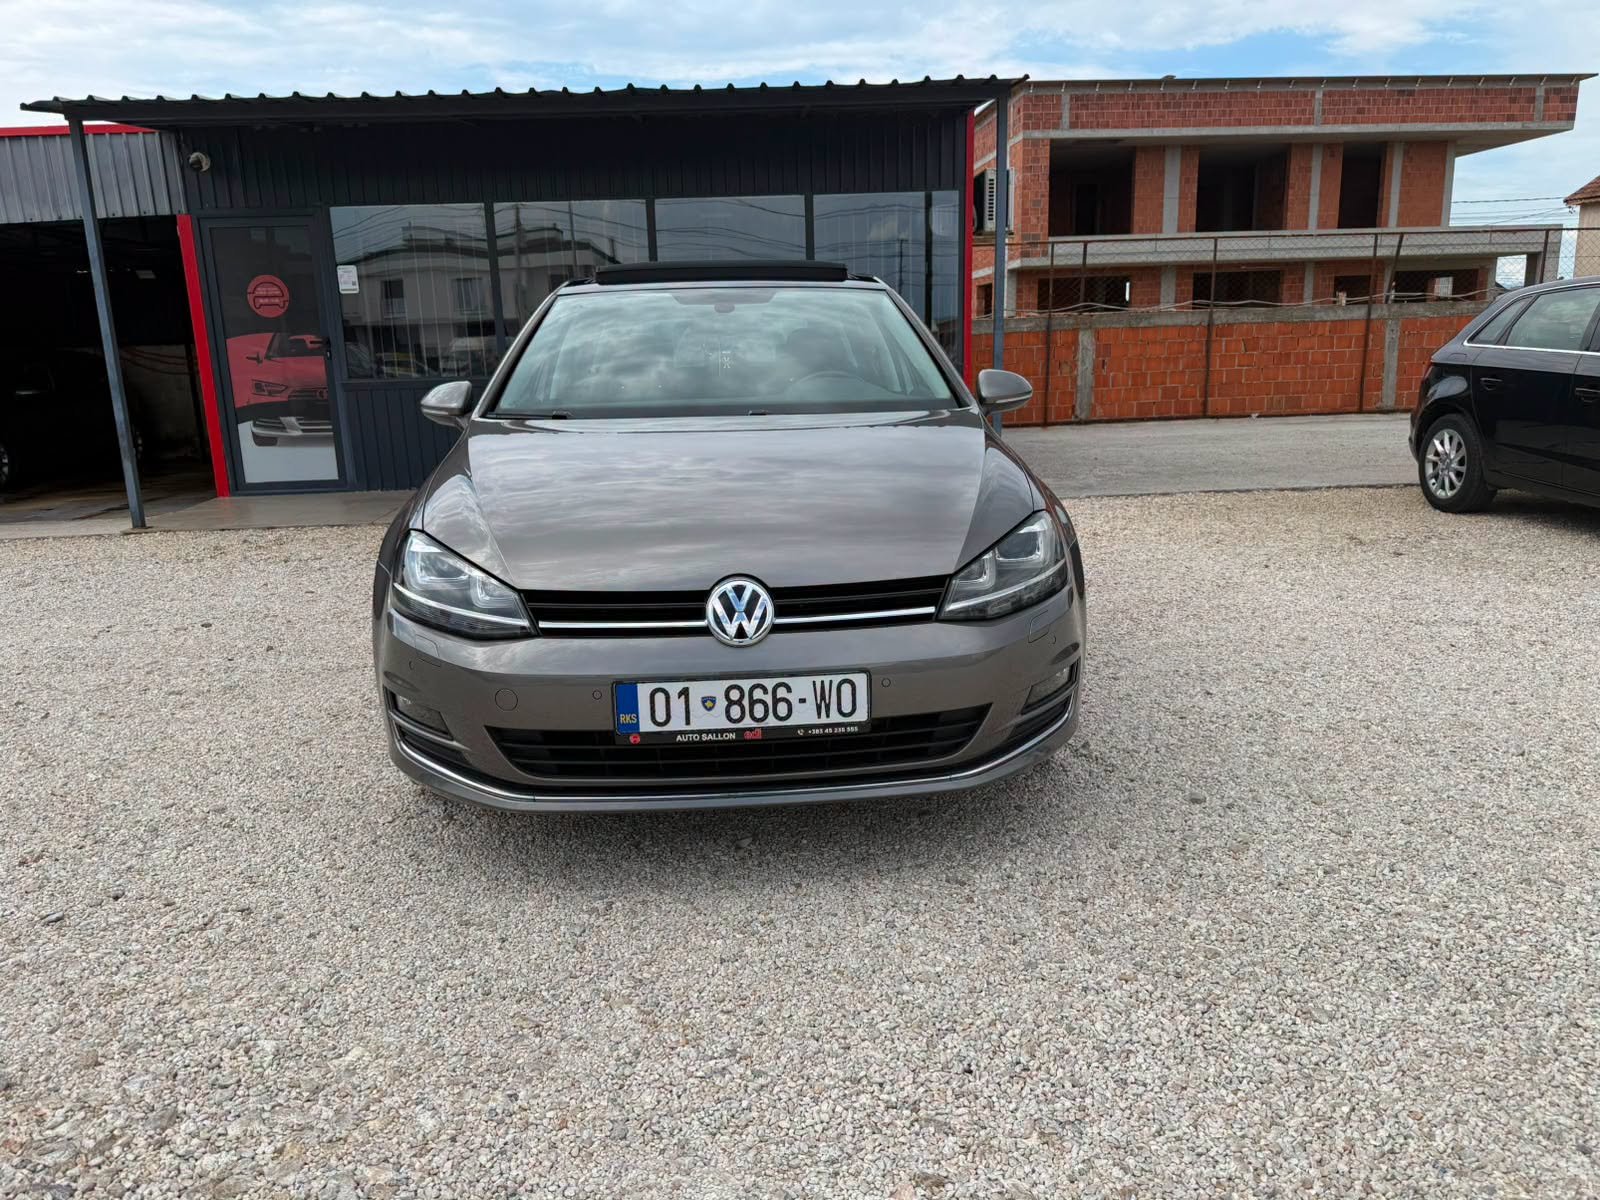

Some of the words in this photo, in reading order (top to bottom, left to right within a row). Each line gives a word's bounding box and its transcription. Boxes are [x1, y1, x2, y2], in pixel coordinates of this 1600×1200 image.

[649, 686, 691, 727] 01
[619, 713, 638, 724] RKS
[701, 732, 736, 741] SALLON
